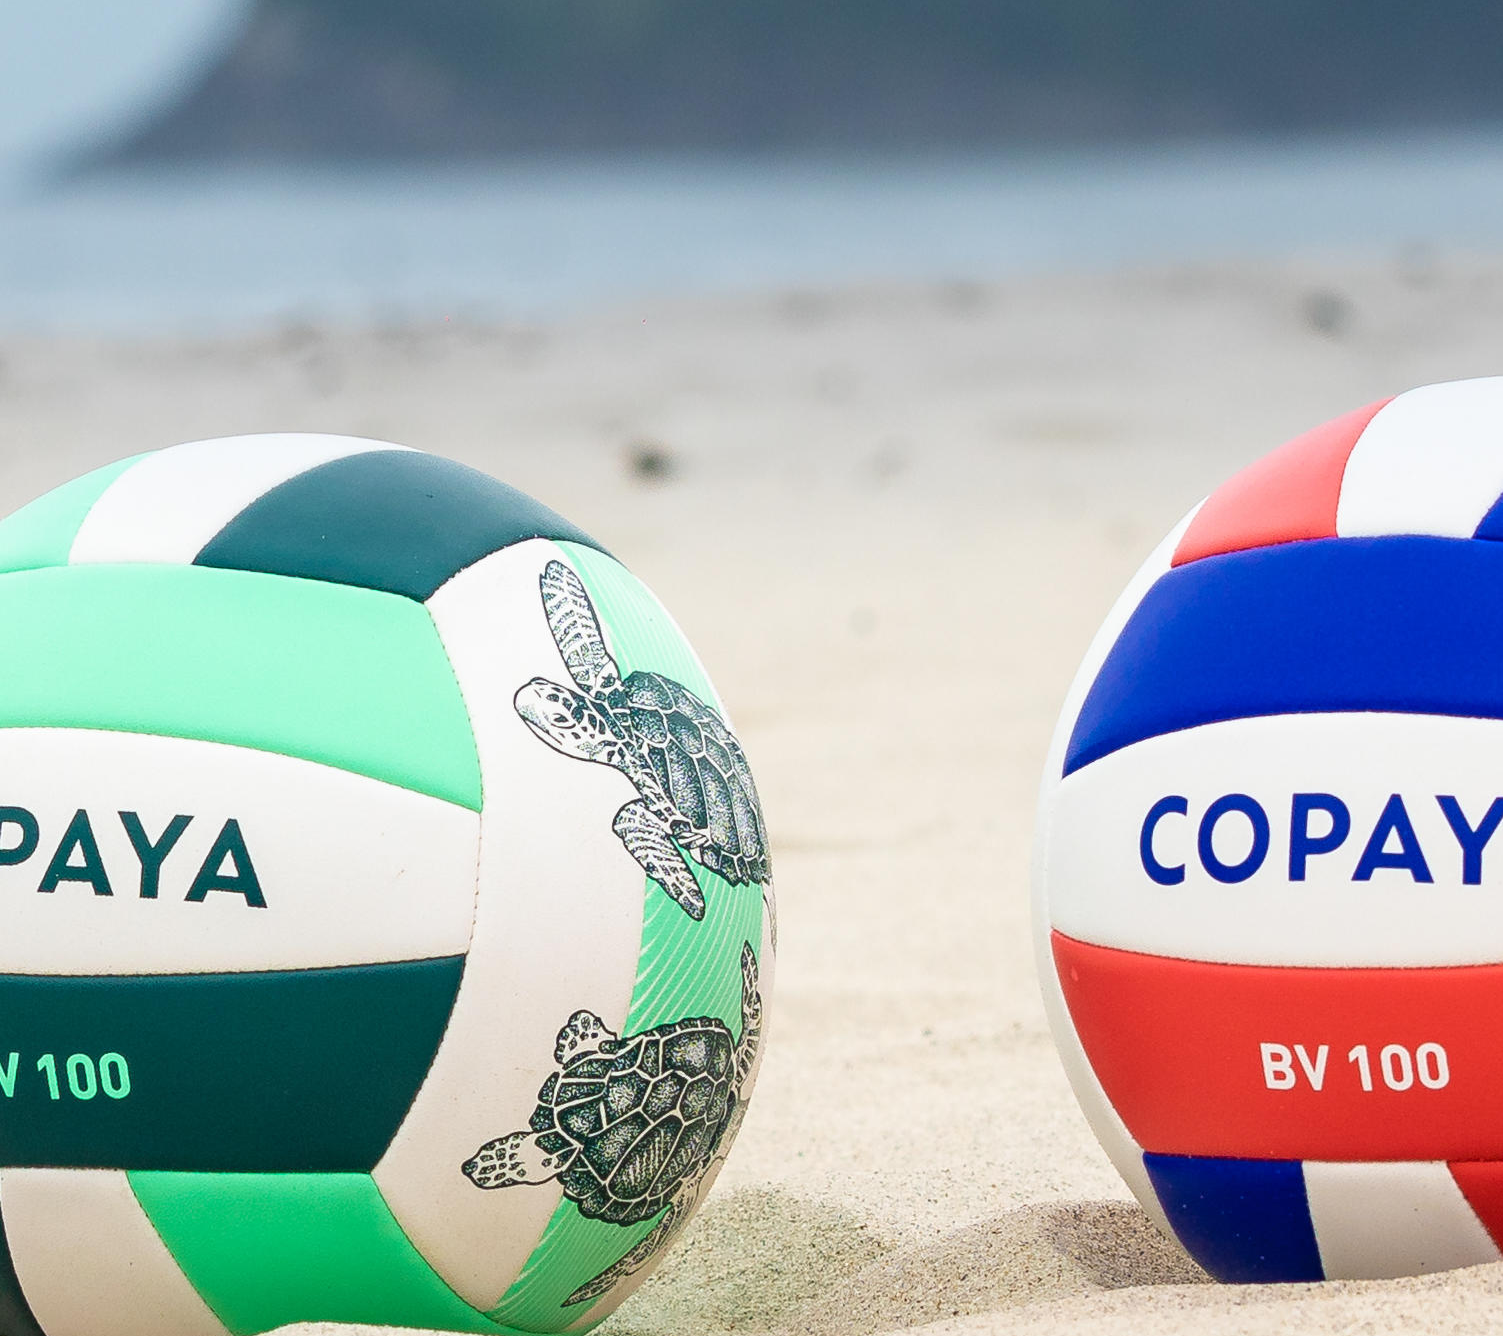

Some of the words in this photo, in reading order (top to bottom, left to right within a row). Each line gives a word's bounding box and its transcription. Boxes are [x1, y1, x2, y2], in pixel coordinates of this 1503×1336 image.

[36, 1052, 131, 1100] 100
[1260, 1042, 1329, 1091] BV
[1348, 1042, 1450, 1092] 100
